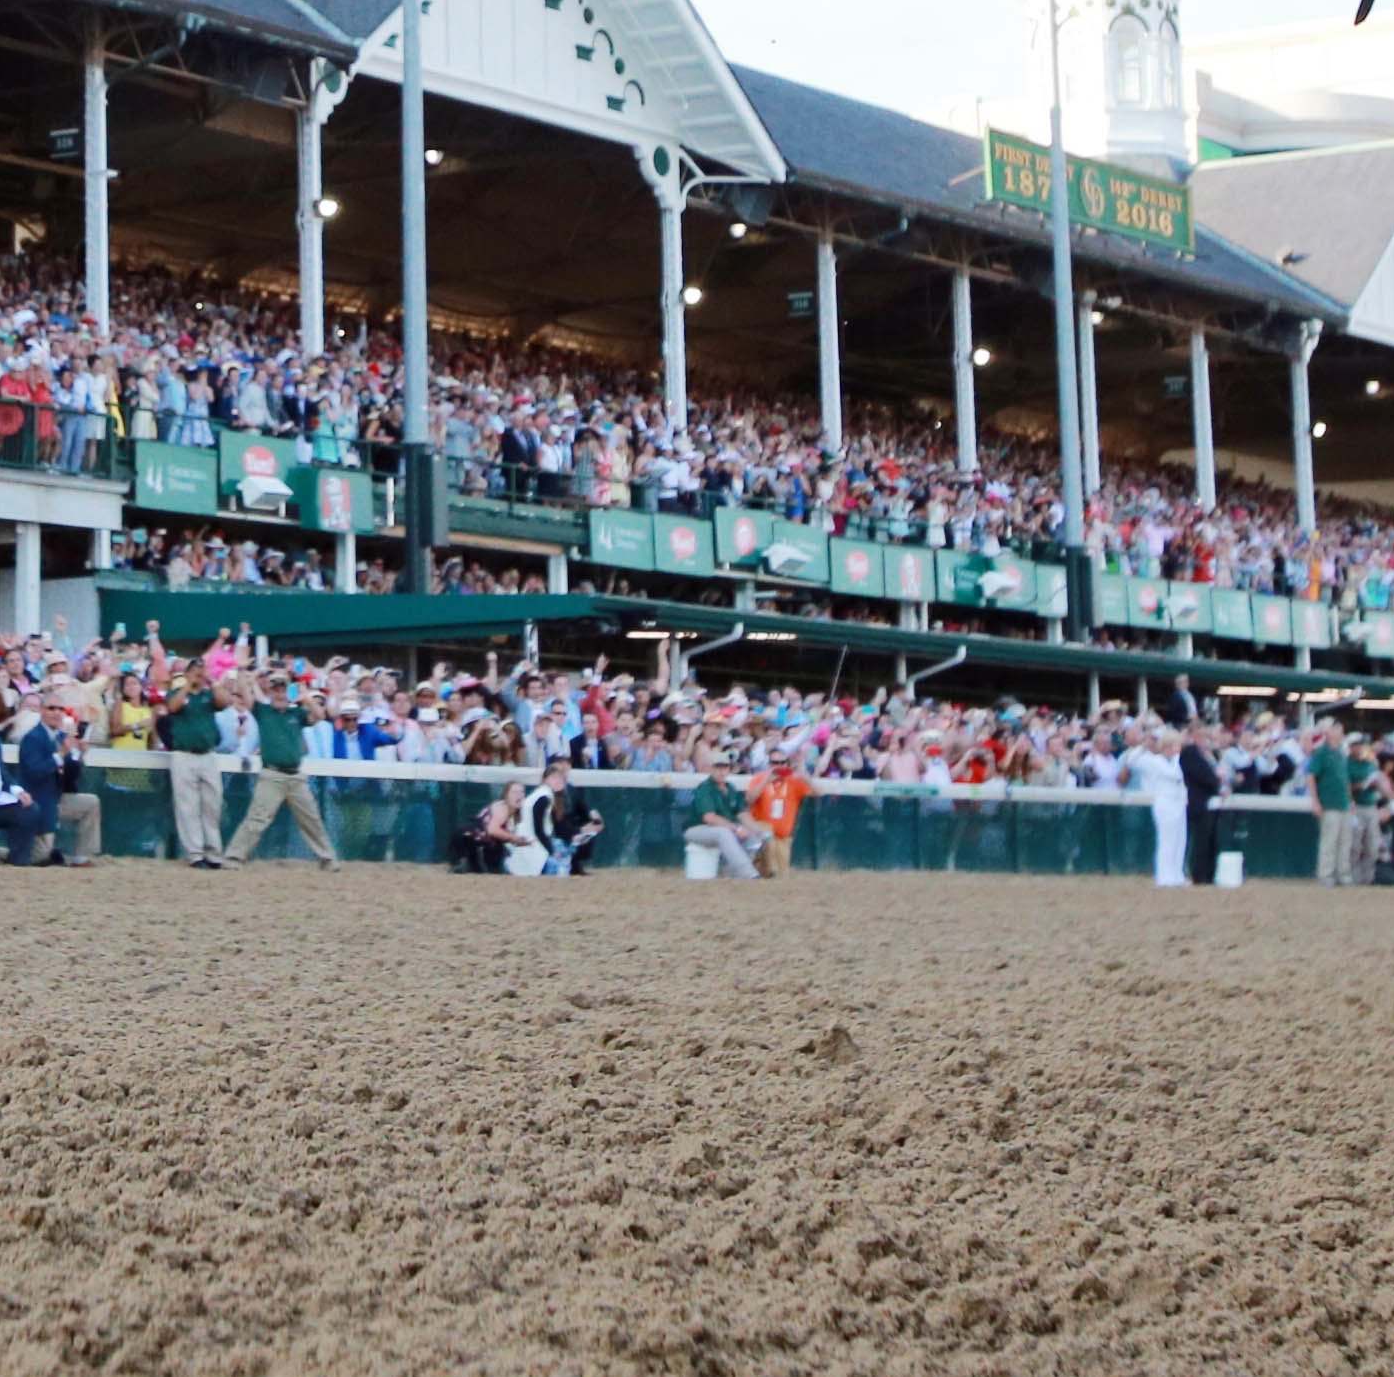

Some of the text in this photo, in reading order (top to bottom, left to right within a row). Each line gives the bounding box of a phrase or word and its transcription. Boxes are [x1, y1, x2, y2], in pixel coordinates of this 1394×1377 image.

[995, 142, 1031, 167] FIRST
[1004, 165, 1052, 202] 187
[1141, 185, 1183, 213] DERBY
[1116, 200, 1174, 237] 2016
